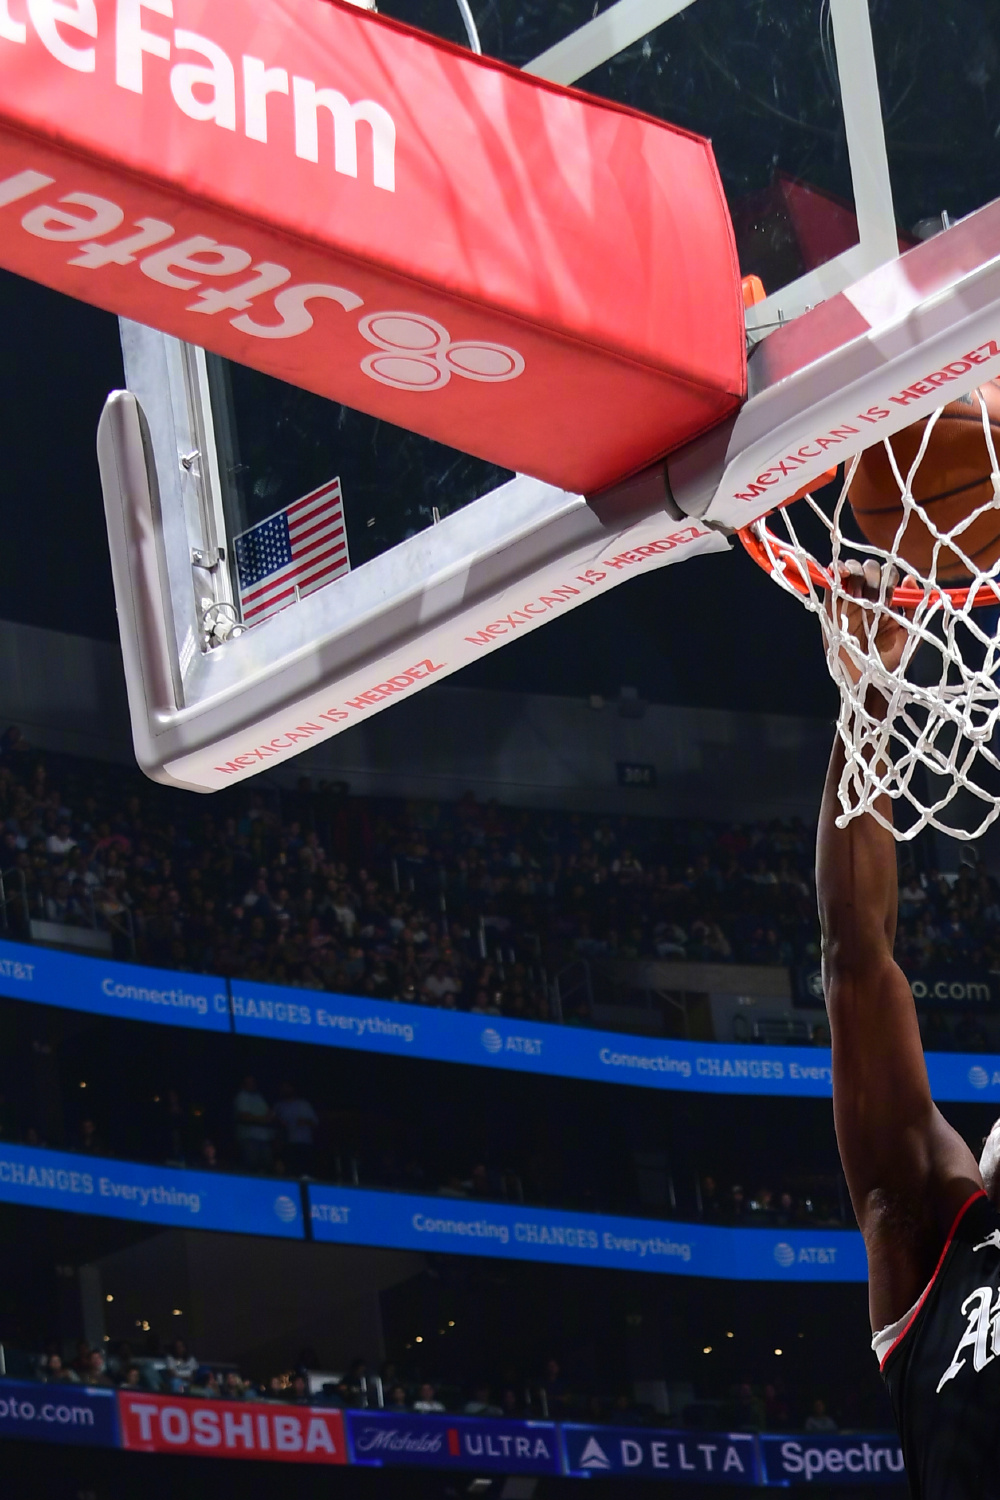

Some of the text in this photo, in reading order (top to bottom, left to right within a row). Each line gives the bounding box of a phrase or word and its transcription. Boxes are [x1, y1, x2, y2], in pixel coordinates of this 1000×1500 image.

[859, 403, 889, 426] IS
[581, 567, 602, 585] IS
[608, 525, 708, 571] HERDEZ
[326, 707, 349, 724] IS
[351, 658, 443, 712] HERDEZ
[101, 978, 414, 1042] Connecting CHANGES Everything
[505, 1035, 543, 1056] AT&T
[600, 1048, 692, 1077] Connecting
[696, 1057, 784, 1080] CHANGES
[0, 1160, 200, 1212] CHANGES Everything
[310, 1204, 350, 1224] AT&T
[413, 1214, 691, 1261] Connecting CHANGES Everything
[798, 1247, 836, 1264] AT&T
[130, 1404, 336, 1454] TOSHIBA
[464, 1434, 550, 1460] ULTRA
[621, 1440, 745, 1473] DELTA
